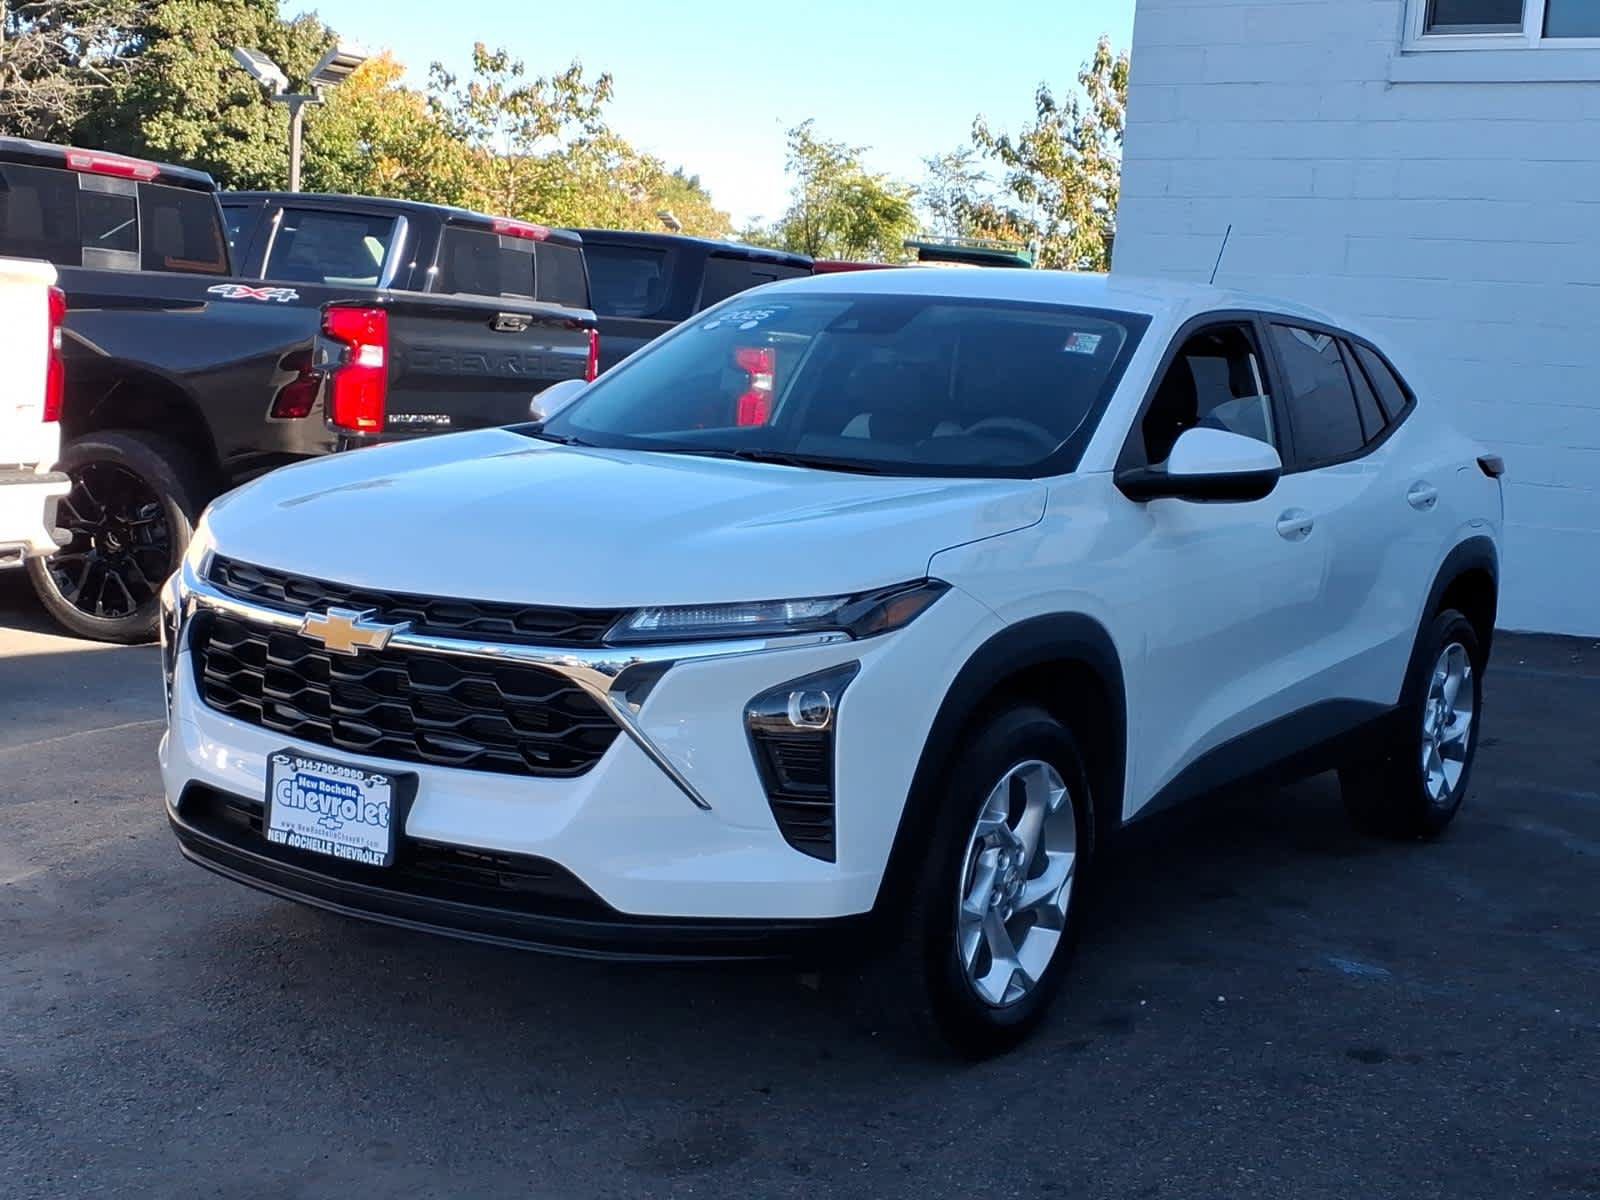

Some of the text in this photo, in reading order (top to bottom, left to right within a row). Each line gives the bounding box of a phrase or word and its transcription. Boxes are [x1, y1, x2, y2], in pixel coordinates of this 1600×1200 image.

[276, 778, 390, 828] Chevrolet
[298, 775, 358, 798] New Rochelle
[267, 829, 386, 867] NEW ROCHELLE CHEVROLET
